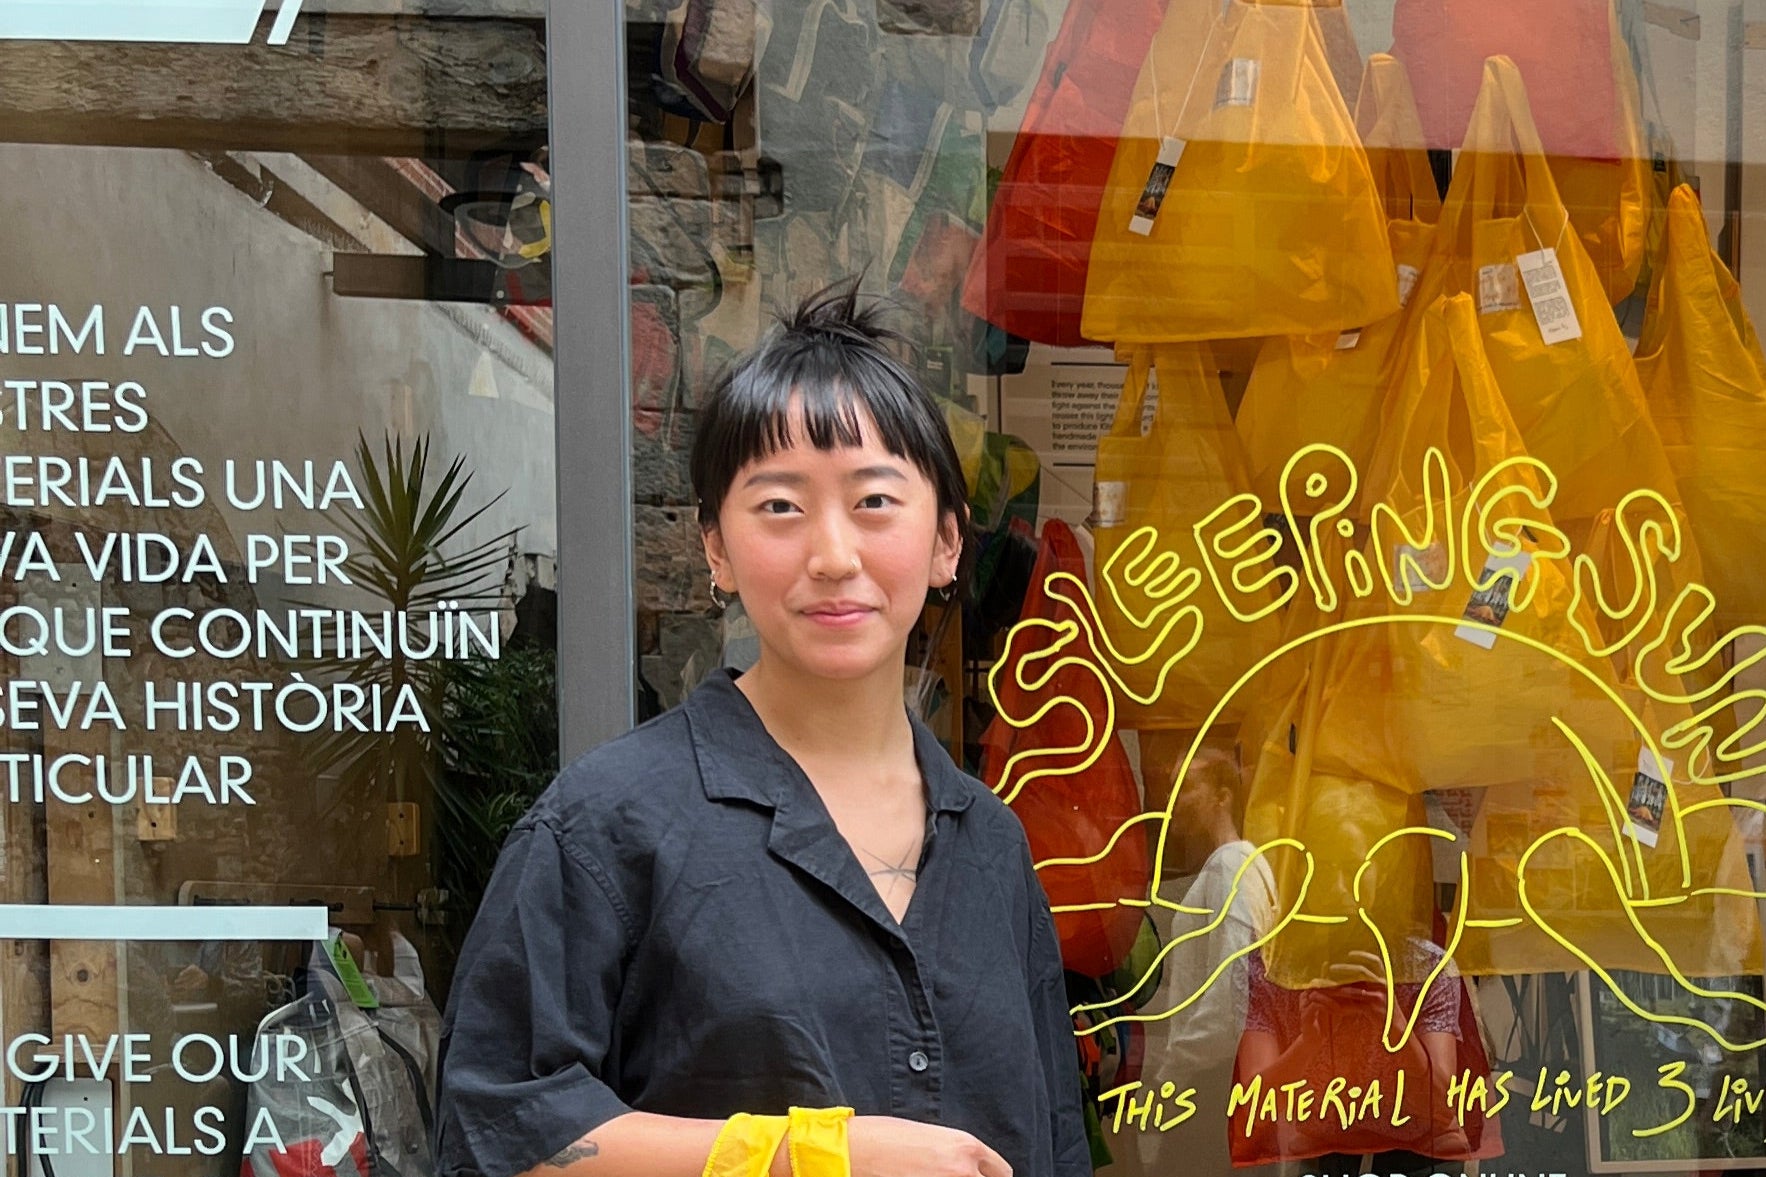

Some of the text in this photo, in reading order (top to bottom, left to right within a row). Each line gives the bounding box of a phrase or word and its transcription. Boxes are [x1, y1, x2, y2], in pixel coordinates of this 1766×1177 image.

[0, 303, 235, 358] EM ALS
[0, 380, 149, 433] TRES
[5, 455, 364, 511] ERIALS UNA
[74, 531, 227, 584] VIDA
[247, 533, 353, 585] PER
[0, 600, 500, 661] QUE CONTINUÏN
[0, 672, 431, 733] EVA HISTÒRIA
[0, 753, 256, 806] TICULAR
[6, 1033, 312, 1083] GIVE OUR
[1447, 1068, 1514, 1127] HAS
[1631, 1060, 1696, 1138] 3
[0, 1106, 287, 1156] TERIALS A
